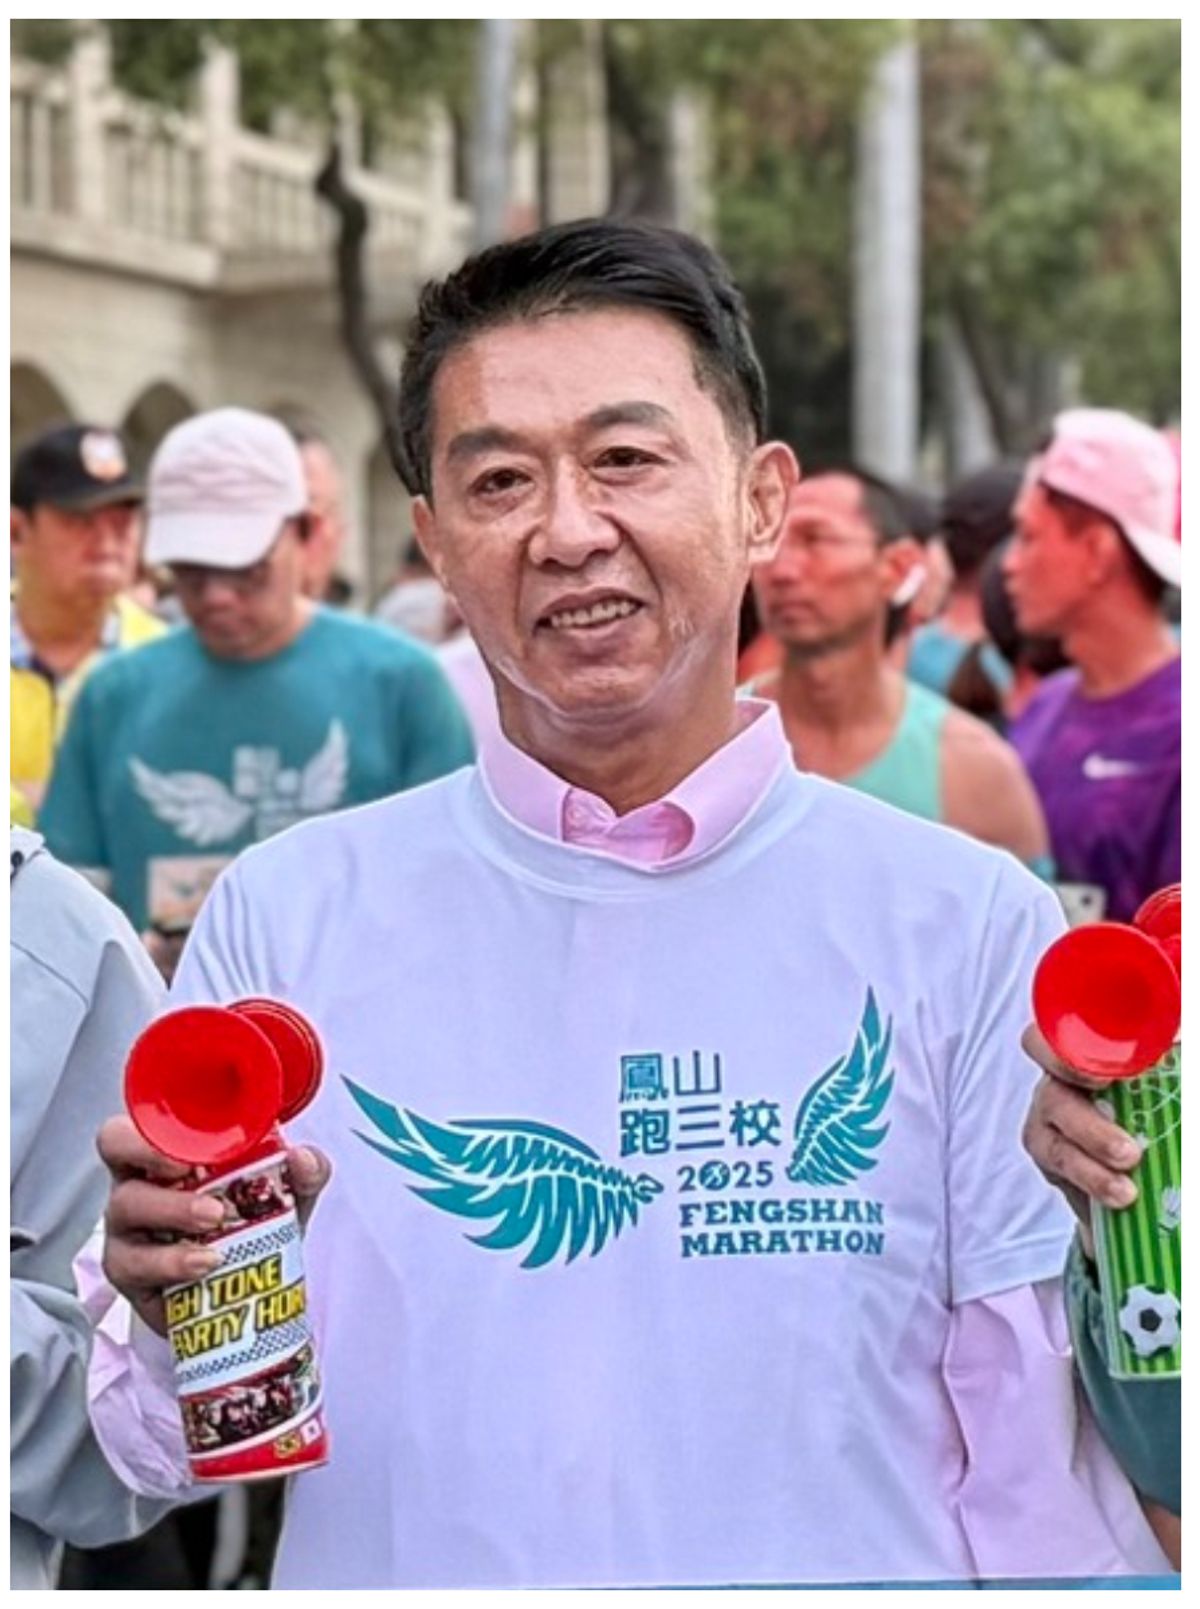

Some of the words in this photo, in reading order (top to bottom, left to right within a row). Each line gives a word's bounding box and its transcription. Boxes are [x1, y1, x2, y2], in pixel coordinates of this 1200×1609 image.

[619, 1050, 722, 1102] 鳳山
[619, 1100, 781, 1157] 跑三校
[677, 1160, 774, 1192] 2025
[679, 1198, 884, 1228] FENGSHAN
[681, 1229, 885, 1258] MARATHON
[166, 1281, 202, 1326] IGH
[206, 1252, 282, 1310] TONE
[171, 1304, 249, 1362] PARTY
[255, 1277, 306, 1332] HOR
